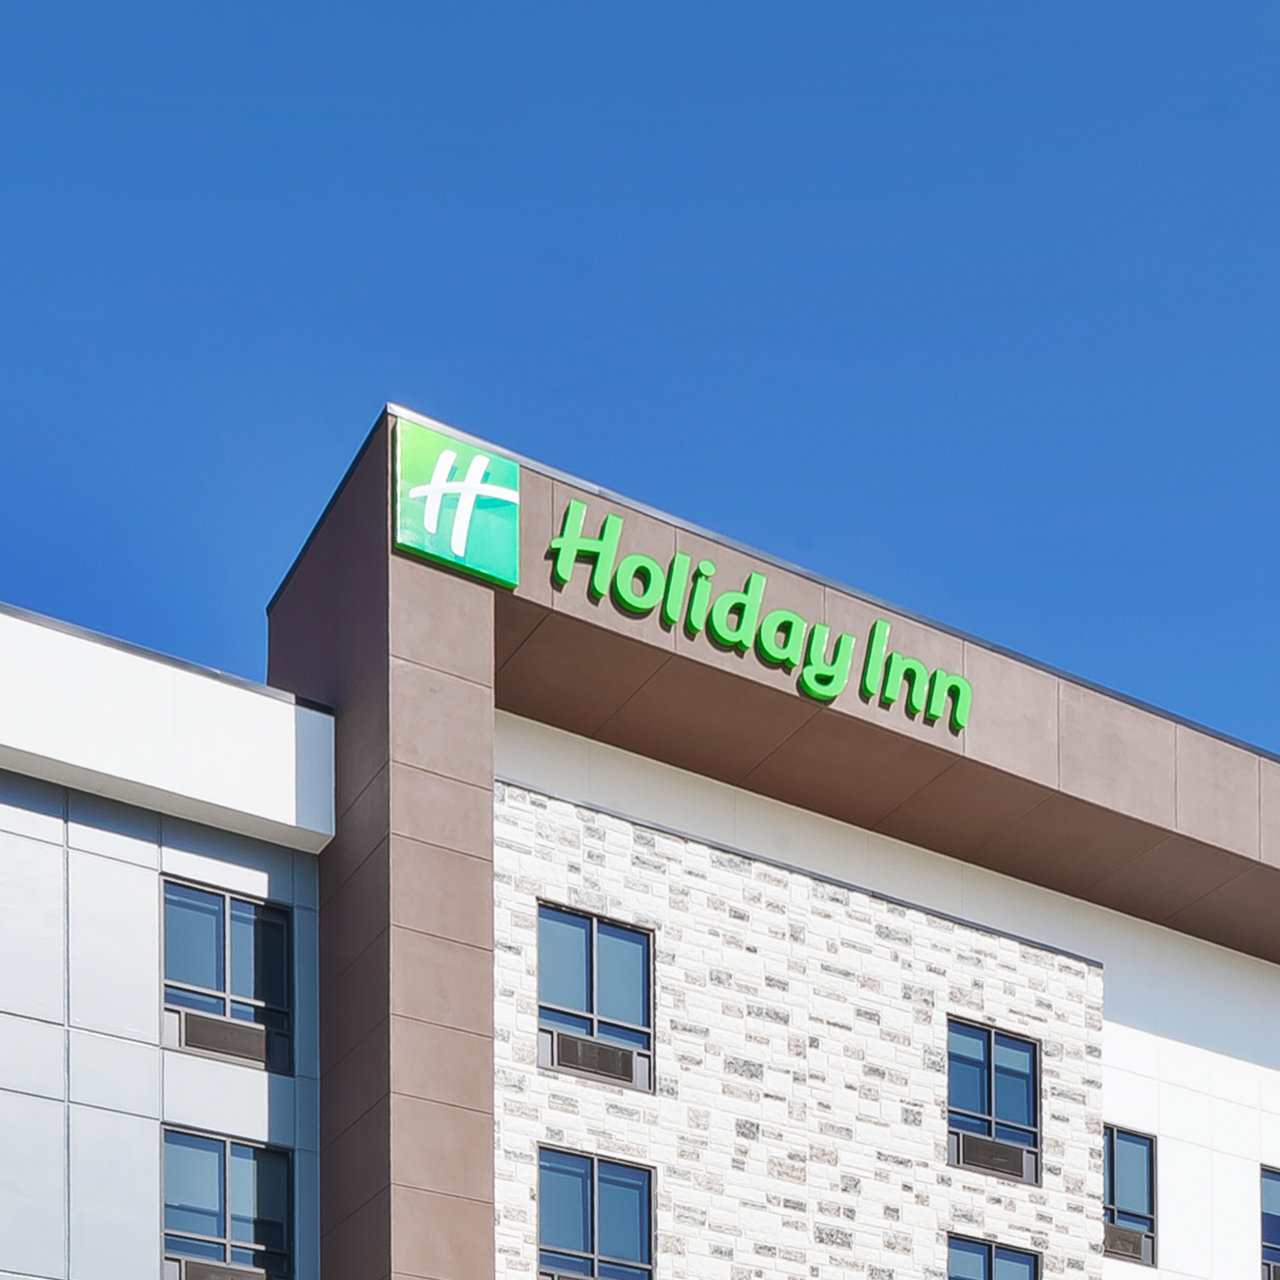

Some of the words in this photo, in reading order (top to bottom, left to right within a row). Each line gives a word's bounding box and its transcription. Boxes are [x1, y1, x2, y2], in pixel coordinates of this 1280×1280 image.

[409, 449, 519, 557] H
[550, 498, 855, 700] Holiday
[860, 619, 973, 731] Inn
